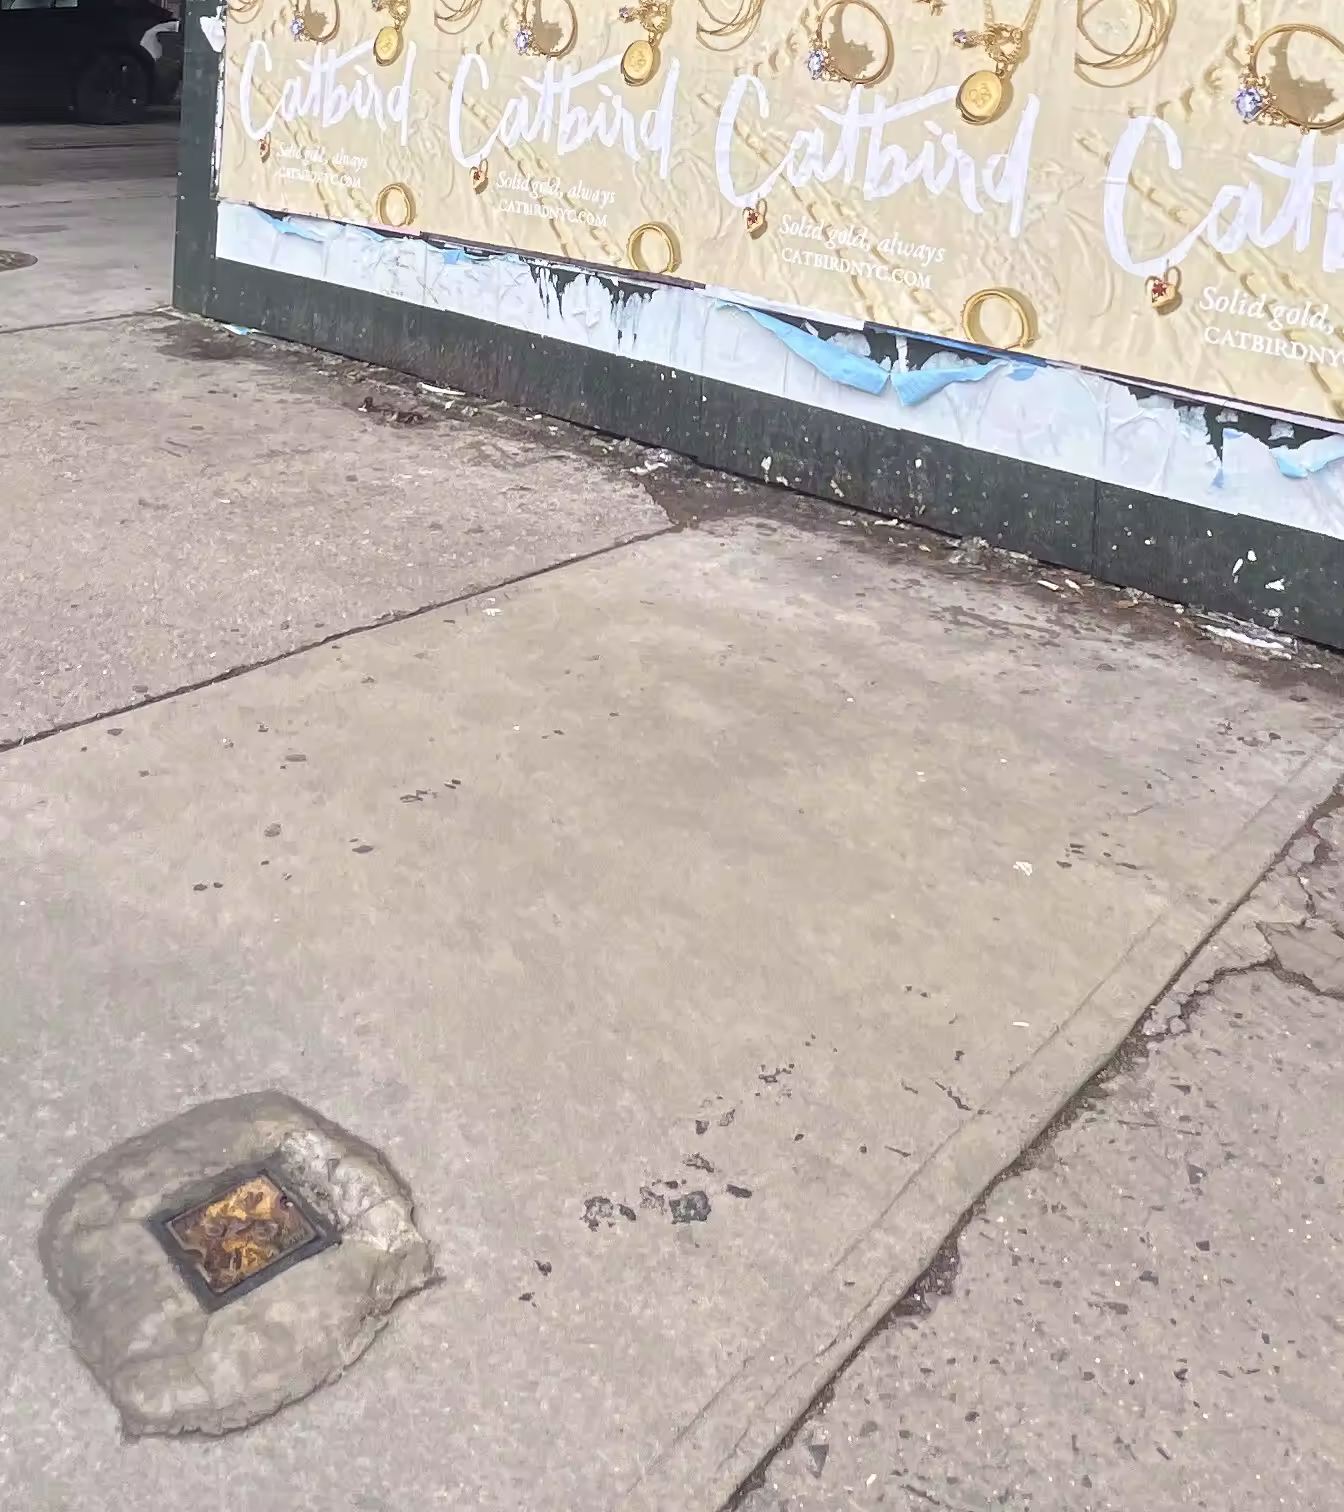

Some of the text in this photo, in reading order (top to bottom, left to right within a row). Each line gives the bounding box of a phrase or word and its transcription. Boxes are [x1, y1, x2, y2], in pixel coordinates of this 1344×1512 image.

[240, 39, 417, 147] Catbird
[449, 54, 680, 179] Catbird
[715, 73, 1040, 237] Catbird
[497, 171, 529, 190] Solid
[567, 180, 616, 208] always
[780, 214, 946, 267] Solid gold, always
[781, 247, 932, 289] CATBIRDNYC.COM
[1199, 286, 1266, 319] Solid
[1267, 301, 1335, 336] gold,
